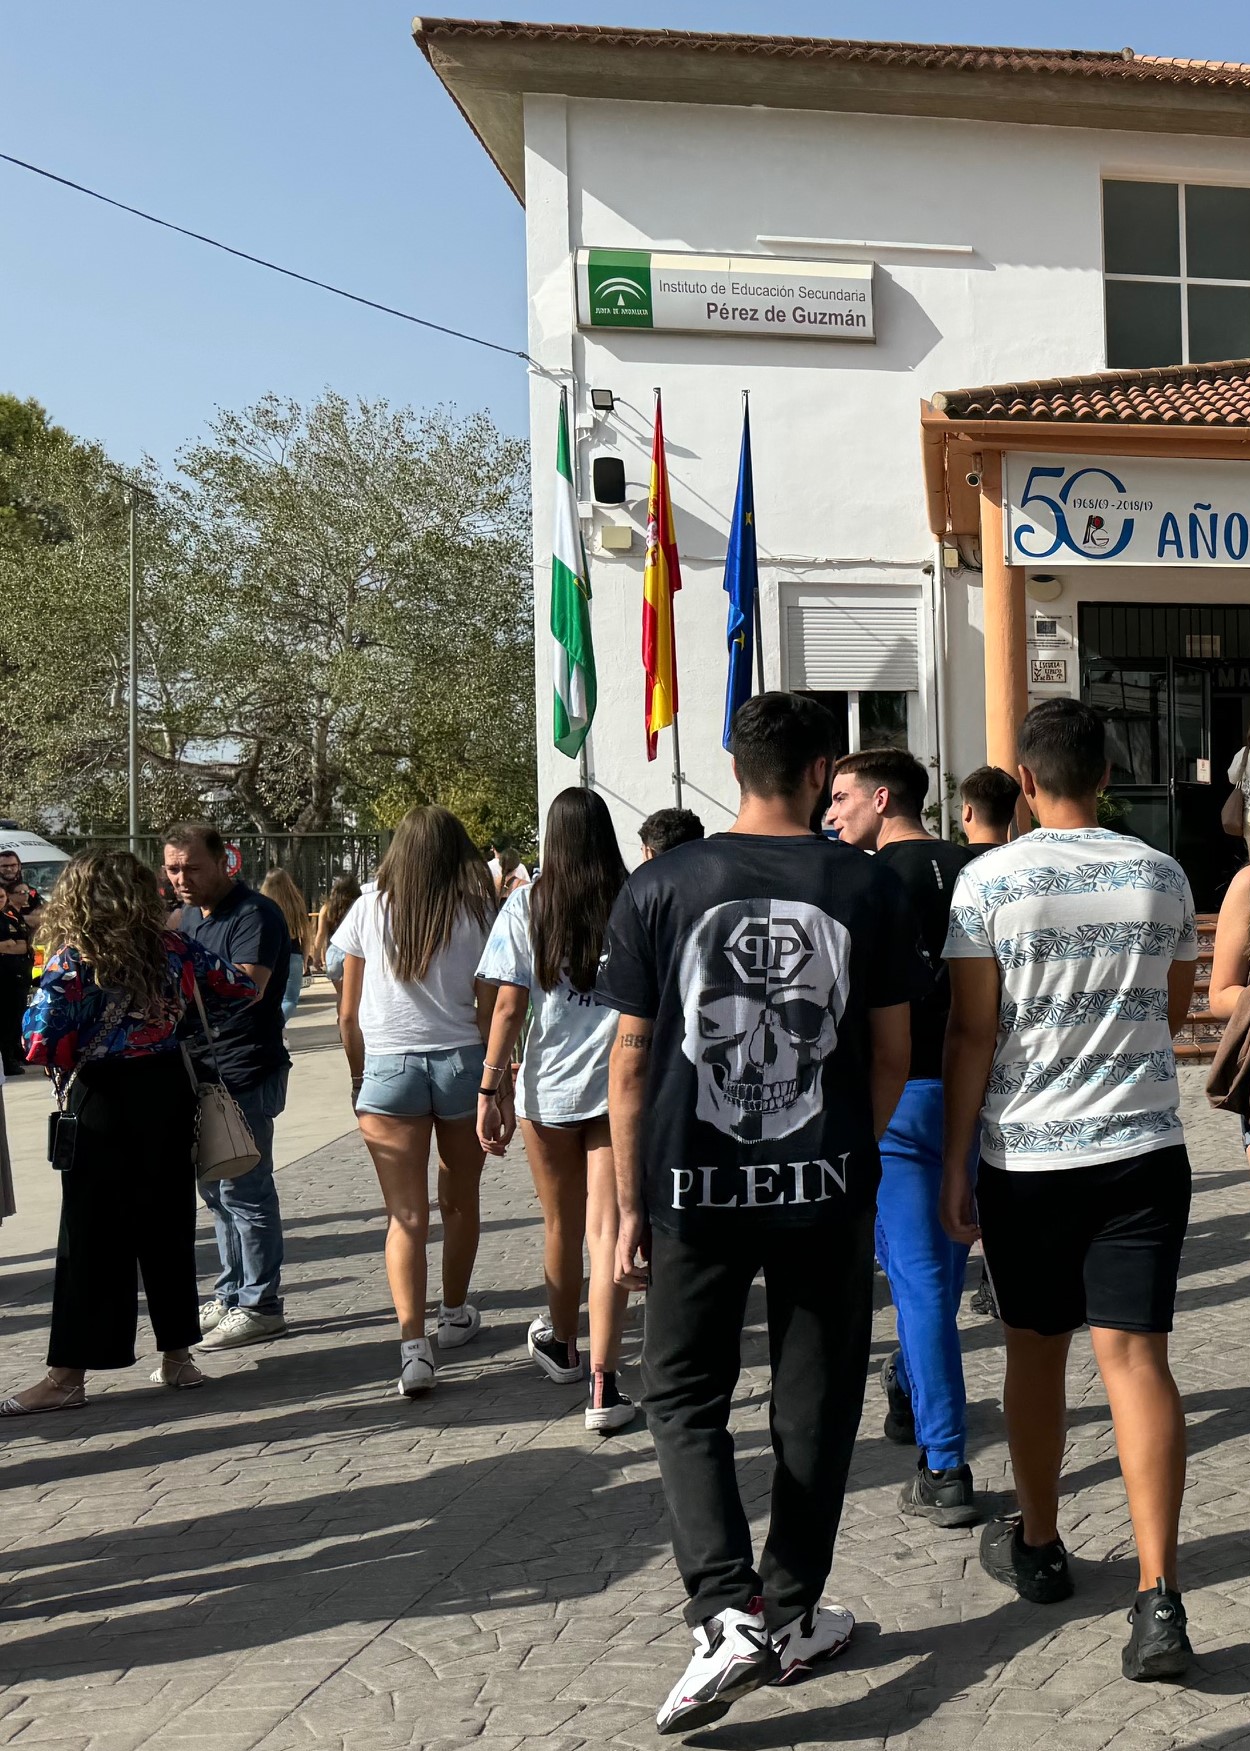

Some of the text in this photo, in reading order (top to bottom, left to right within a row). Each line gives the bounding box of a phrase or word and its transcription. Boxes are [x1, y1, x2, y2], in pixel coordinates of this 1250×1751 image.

[659, 279, 866, 302] Instituto de Educación Secundaria
[706, 302, 867, 328] Pérez de Guzmán
[1014, 467, 1134, 559] 50
[670, 1152, 850, 1210] PLEIN
